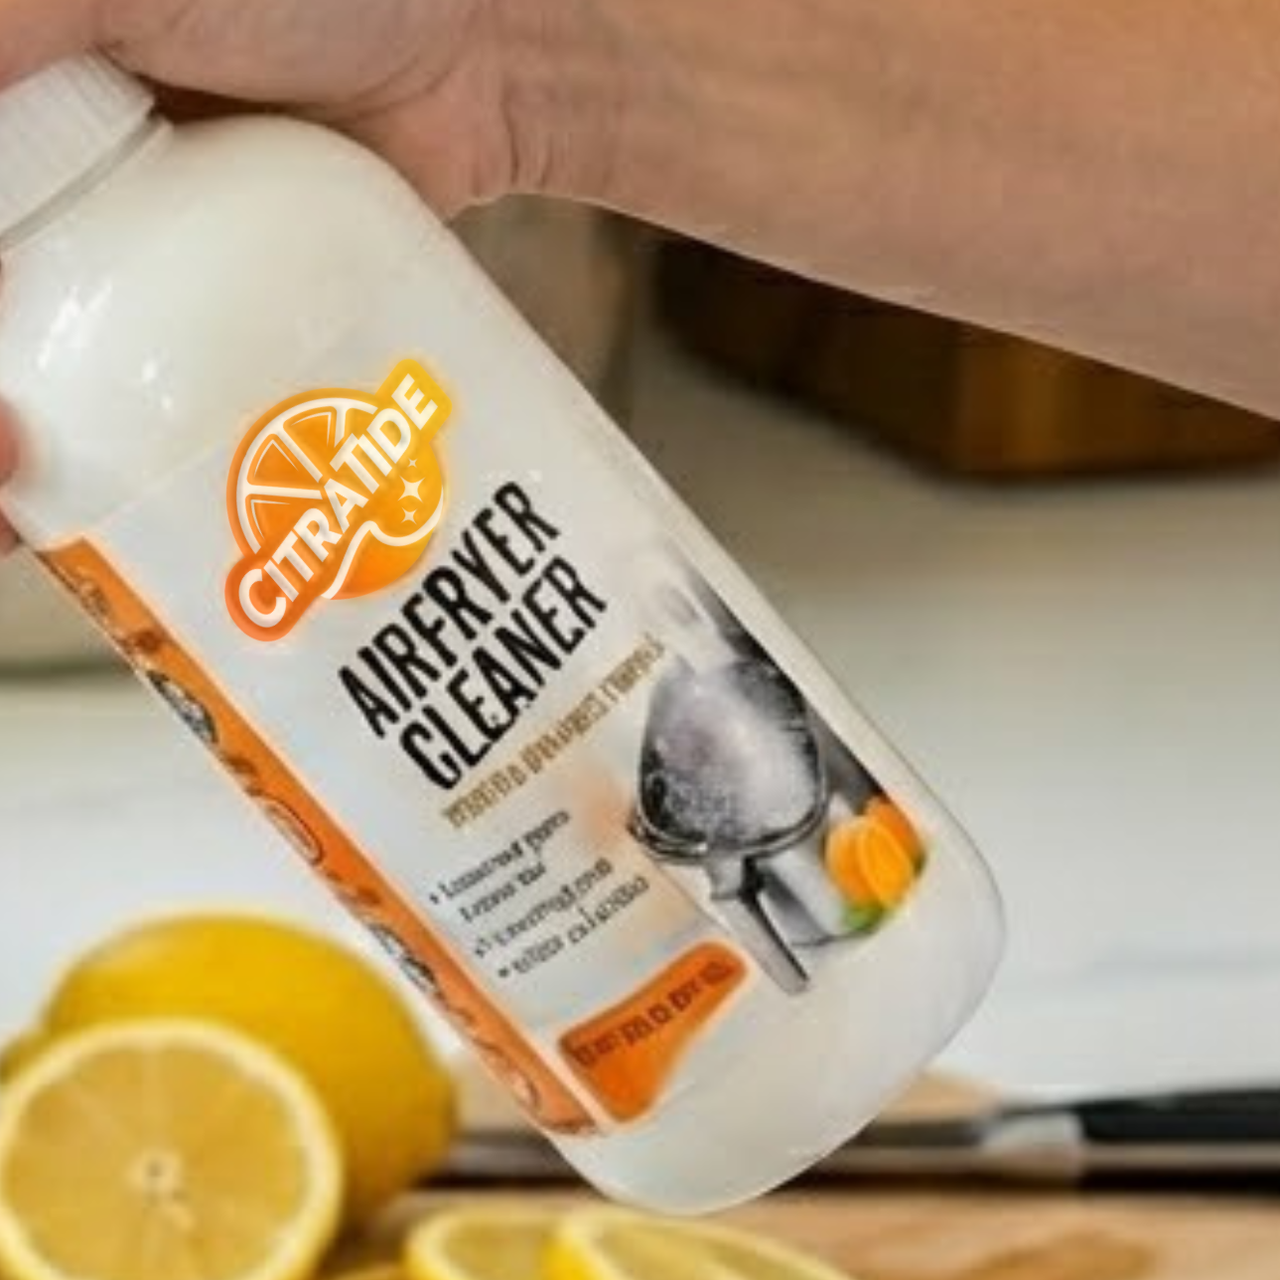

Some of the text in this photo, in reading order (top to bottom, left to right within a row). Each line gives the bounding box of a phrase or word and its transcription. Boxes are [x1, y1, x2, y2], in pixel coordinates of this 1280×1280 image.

[238, 375, 438, 628] CITRATIDE
[338, 482, 560, 737] AIRFRYER
[401, 557, 607, 790] CLEANER
